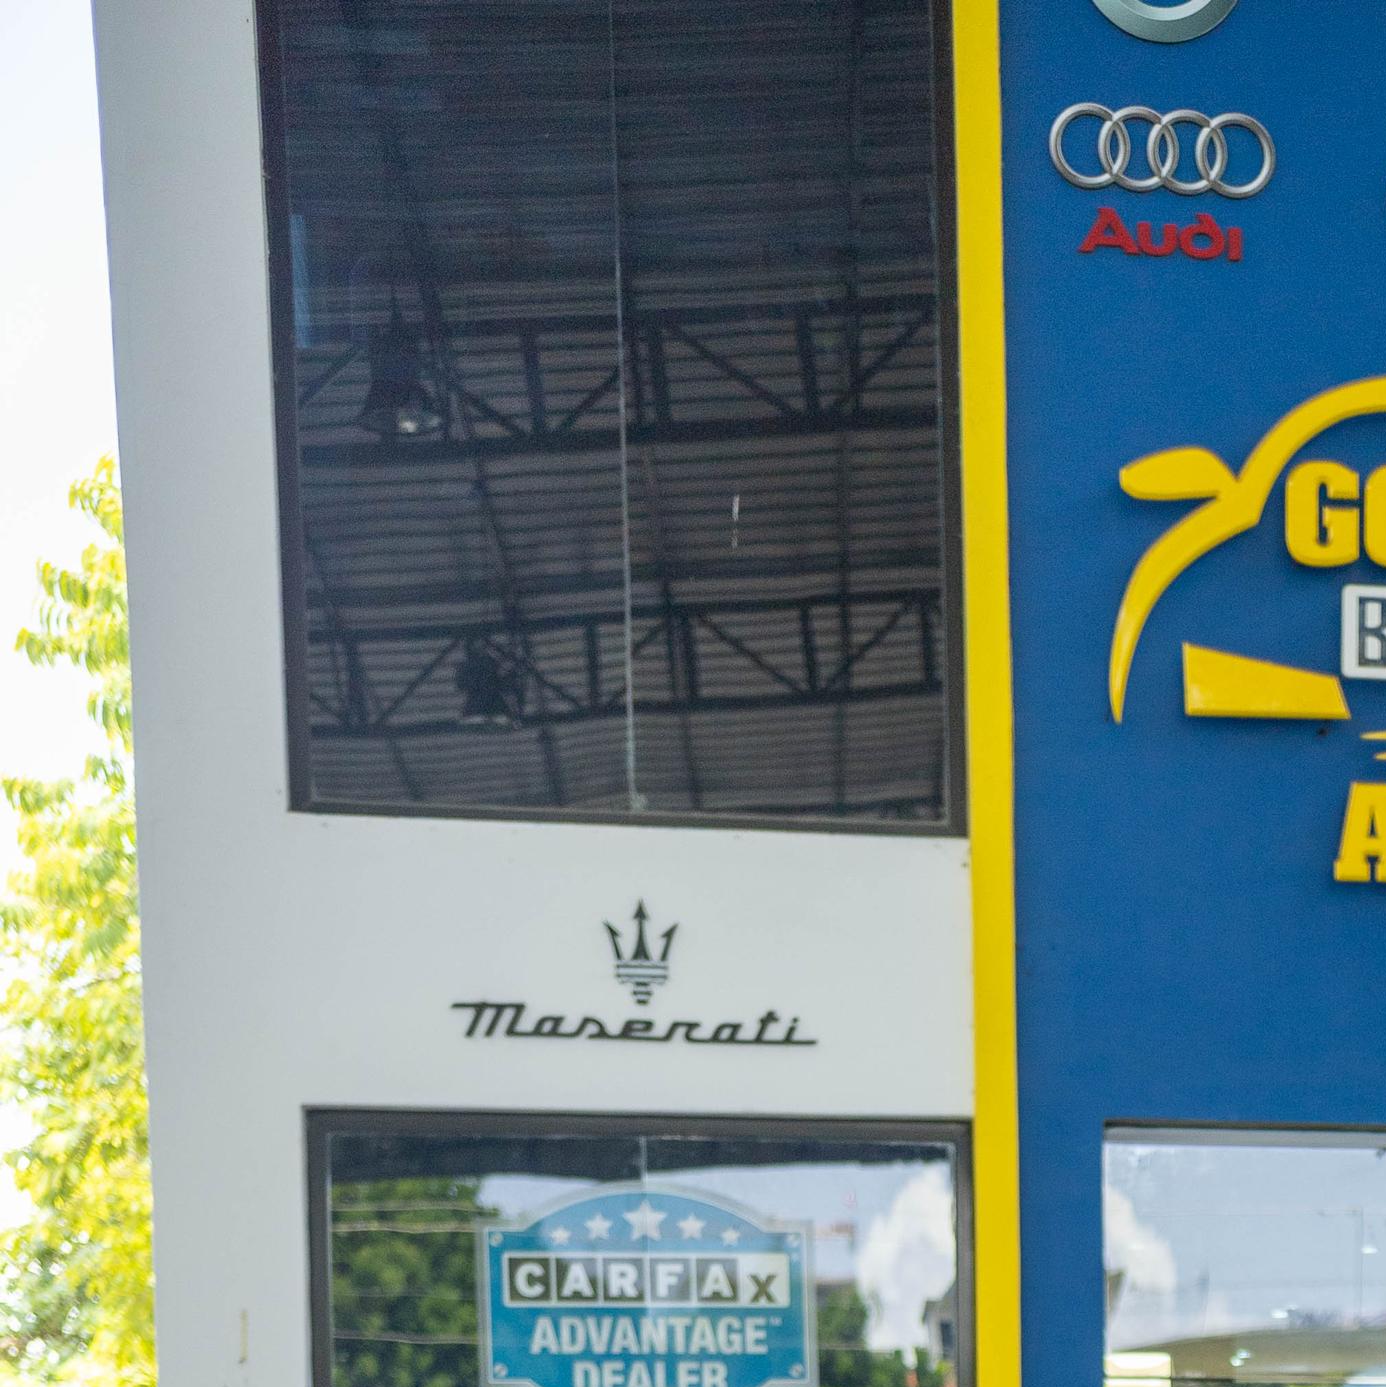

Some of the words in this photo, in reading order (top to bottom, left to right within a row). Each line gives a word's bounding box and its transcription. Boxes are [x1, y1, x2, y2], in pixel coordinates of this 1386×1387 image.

[1079, 207, 1244, 262] Audi
[450, 1001, 819, 1046] Maserati
[512, 1262, 780, 1305] CARFAX
[529, 1314, 769, 1356] ADVANTAGE
